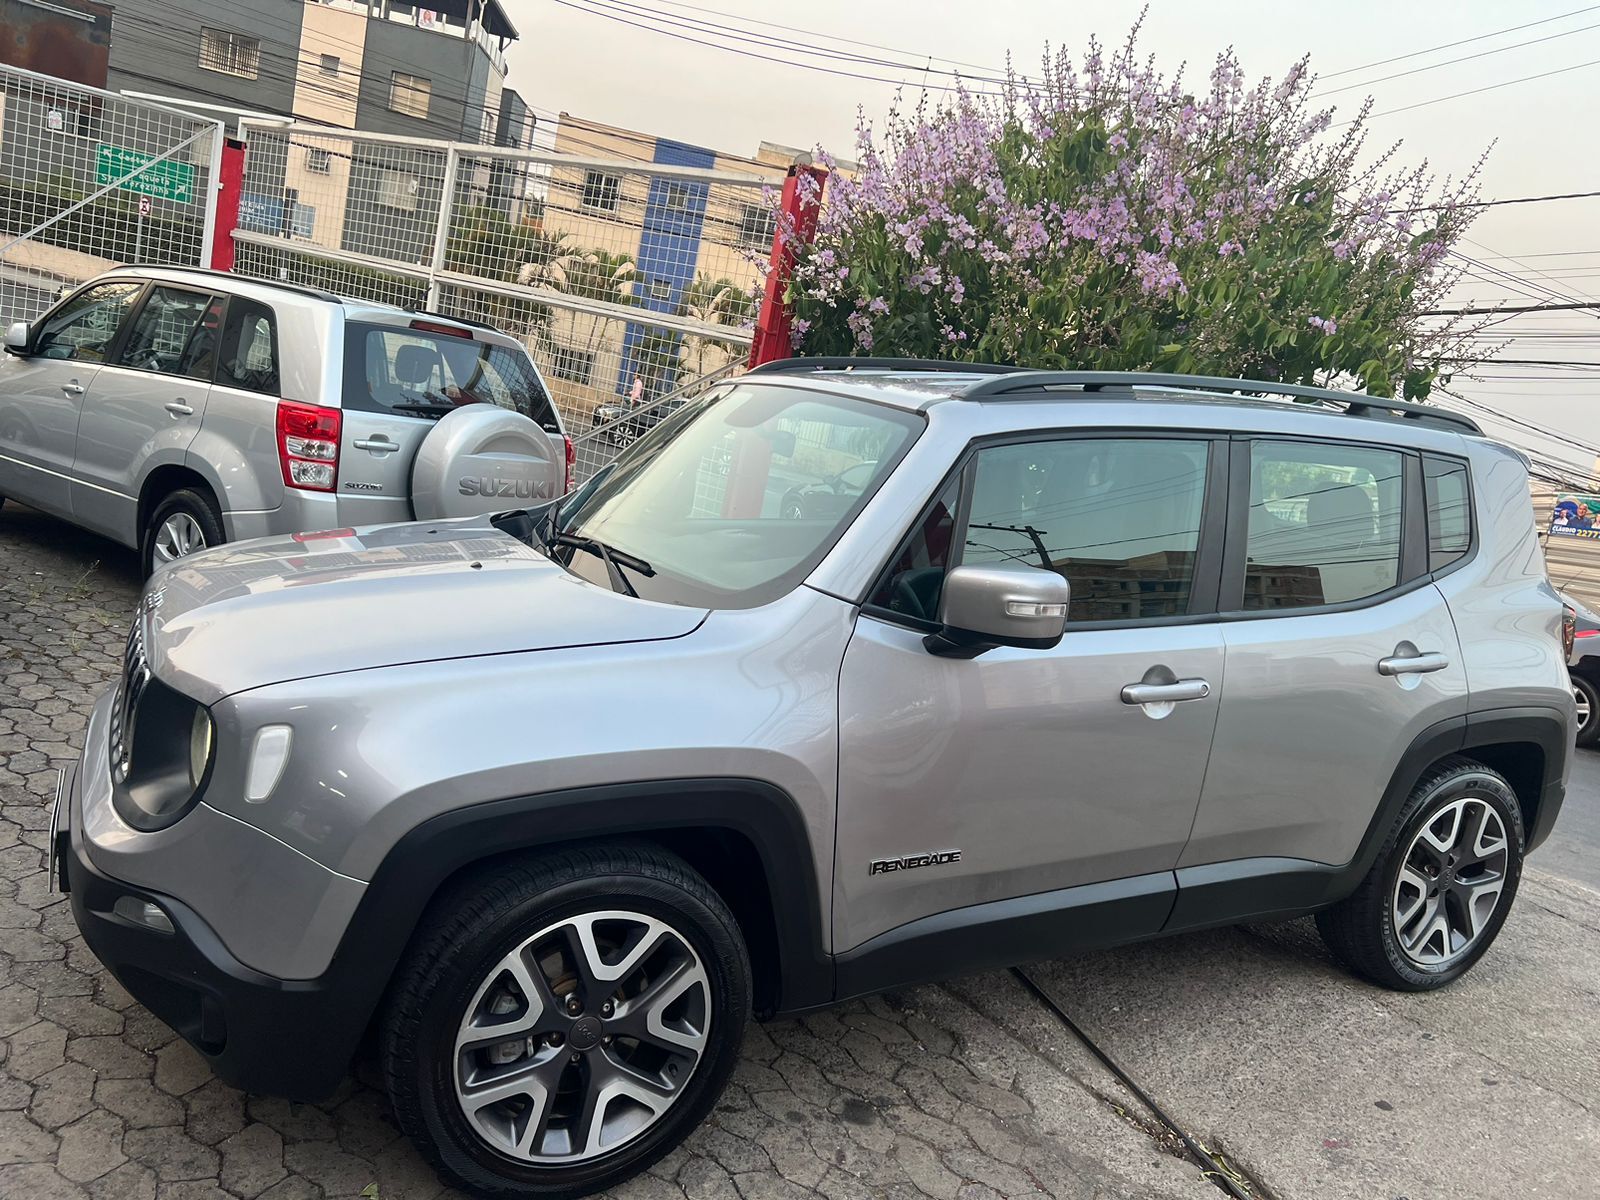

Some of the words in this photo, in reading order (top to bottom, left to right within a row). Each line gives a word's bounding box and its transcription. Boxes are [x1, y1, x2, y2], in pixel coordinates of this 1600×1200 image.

[459, 475, 554, 498] SUZUKI
[1577, 529, 1600, 538] 2277
[868, 849, 962, 876] RENEGADE
